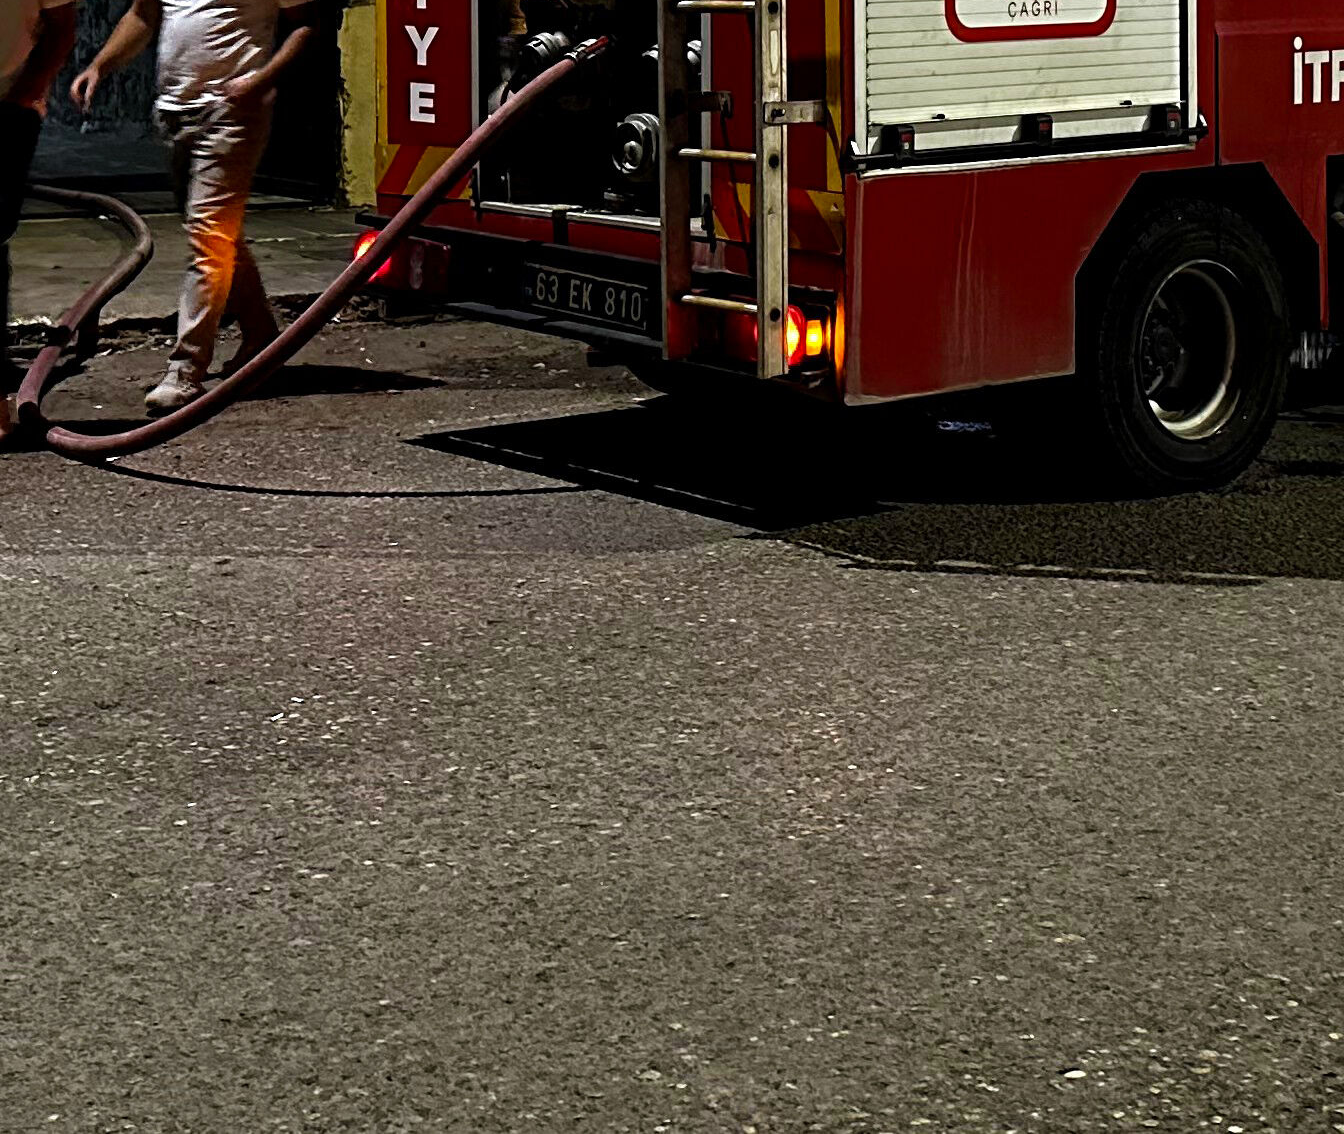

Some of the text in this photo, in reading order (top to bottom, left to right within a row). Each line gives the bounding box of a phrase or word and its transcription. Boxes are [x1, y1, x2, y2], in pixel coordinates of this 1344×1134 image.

[536, 272, 642, 322] 63 EK 810
